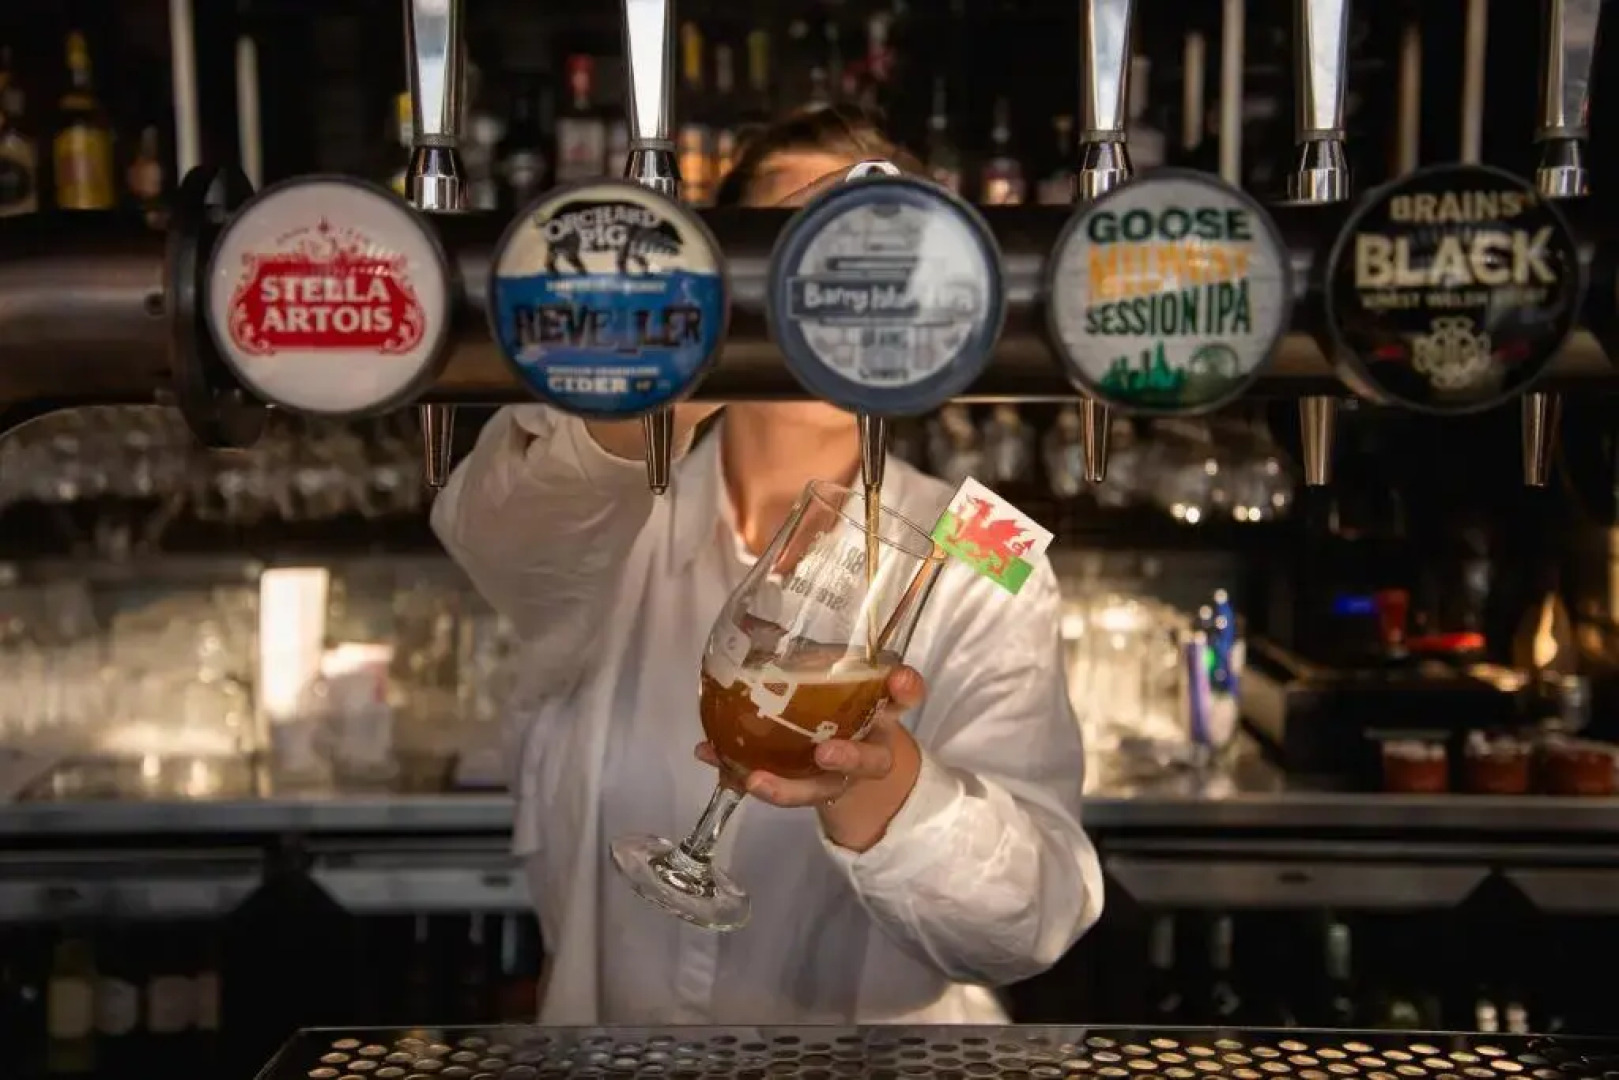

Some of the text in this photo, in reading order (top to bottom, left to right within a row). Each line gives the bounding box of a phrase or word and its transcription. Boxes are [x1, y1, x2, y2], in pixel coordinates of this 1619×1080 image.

[1088, 206, 1252, 243] GOOSE
[1354, 226, 1557, 289] BLACK
[260, 276, 391, 303] STELLA
[1085, 278, 1251, 336] SESSION IPA
[261, 306, 394, 333] ARTOIS
